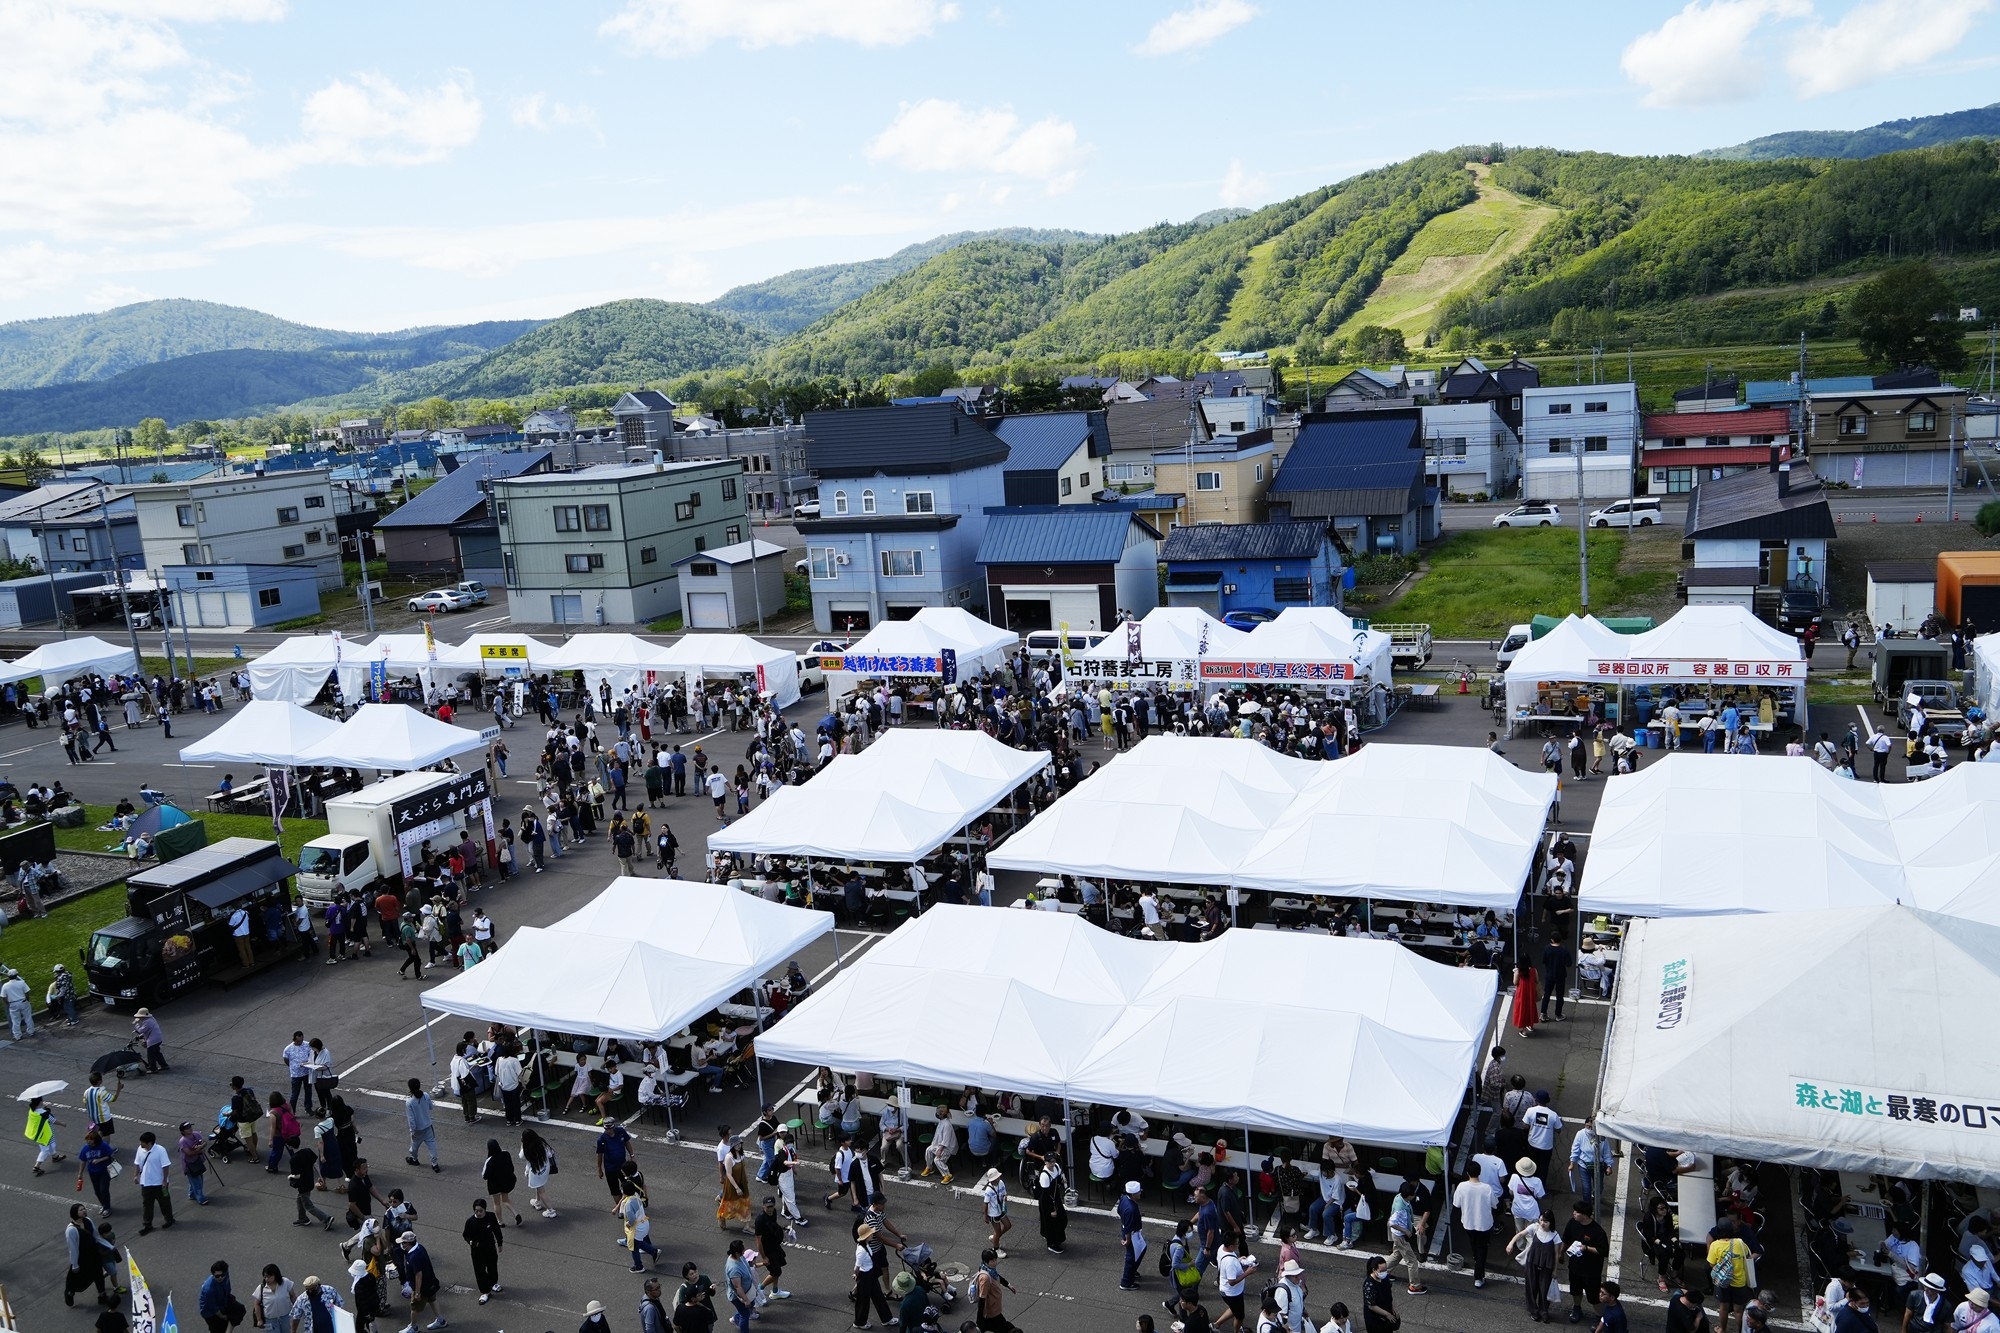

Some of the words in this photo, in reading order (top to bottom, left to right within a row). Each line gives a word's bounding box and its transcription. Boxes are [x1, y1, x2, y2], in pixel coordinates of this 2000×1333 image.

[1862, 443, 1909, 452] MIZUTANI
[488, 648, 519, 656] 本部席
[823, 659, 841, 667] 福井県
[842, 655, 937, 673] 越前けんぞう蕎麦
[1067, 660, 1173, 678] 石狩蕎麦工房
[1597, 663, 1670, 675] 容器回収所
[1204, 665, 1233, 674] 新潟県
[1236, 662, 1346, 680] 小嶋屋総本店
[1693, 663, 1793, 676] 容器回収所
[399, 780, 485, 824] 天ぷら専門店
